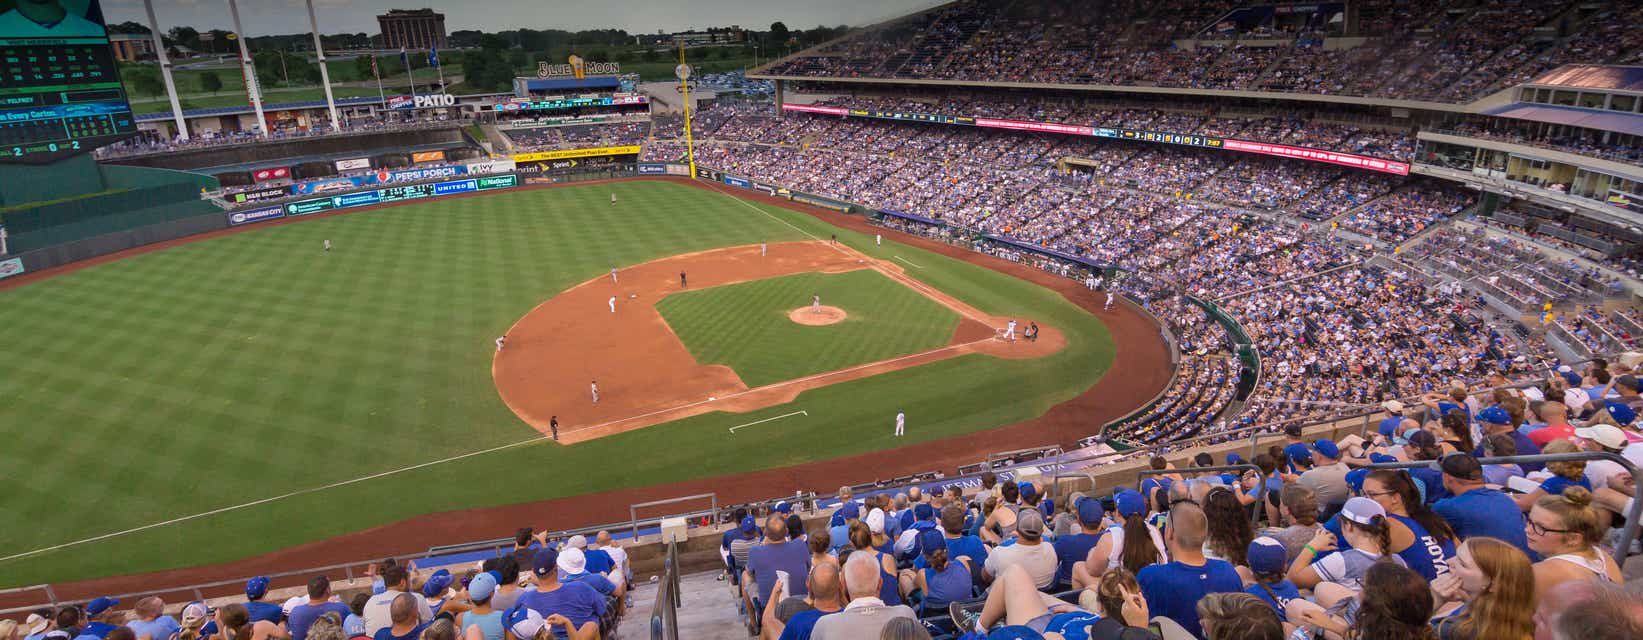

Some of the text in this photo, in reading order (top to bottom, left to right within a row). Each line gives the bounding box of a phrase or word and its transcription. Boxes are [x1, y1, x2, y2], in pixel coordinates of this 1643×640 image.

[537, 61, 619, 79] BLUE MOON
[414, 95, 454, 107] PATIO
[14, 148, 23, 156] 2
[49, 143, 57, 152] 0
[72, 141, 80, 149] 2
[396, 167, 455, 182] PEPSI PORCH
[518, 165, 538, 173] print
[1421, 536, 1449, 576] ROYA
